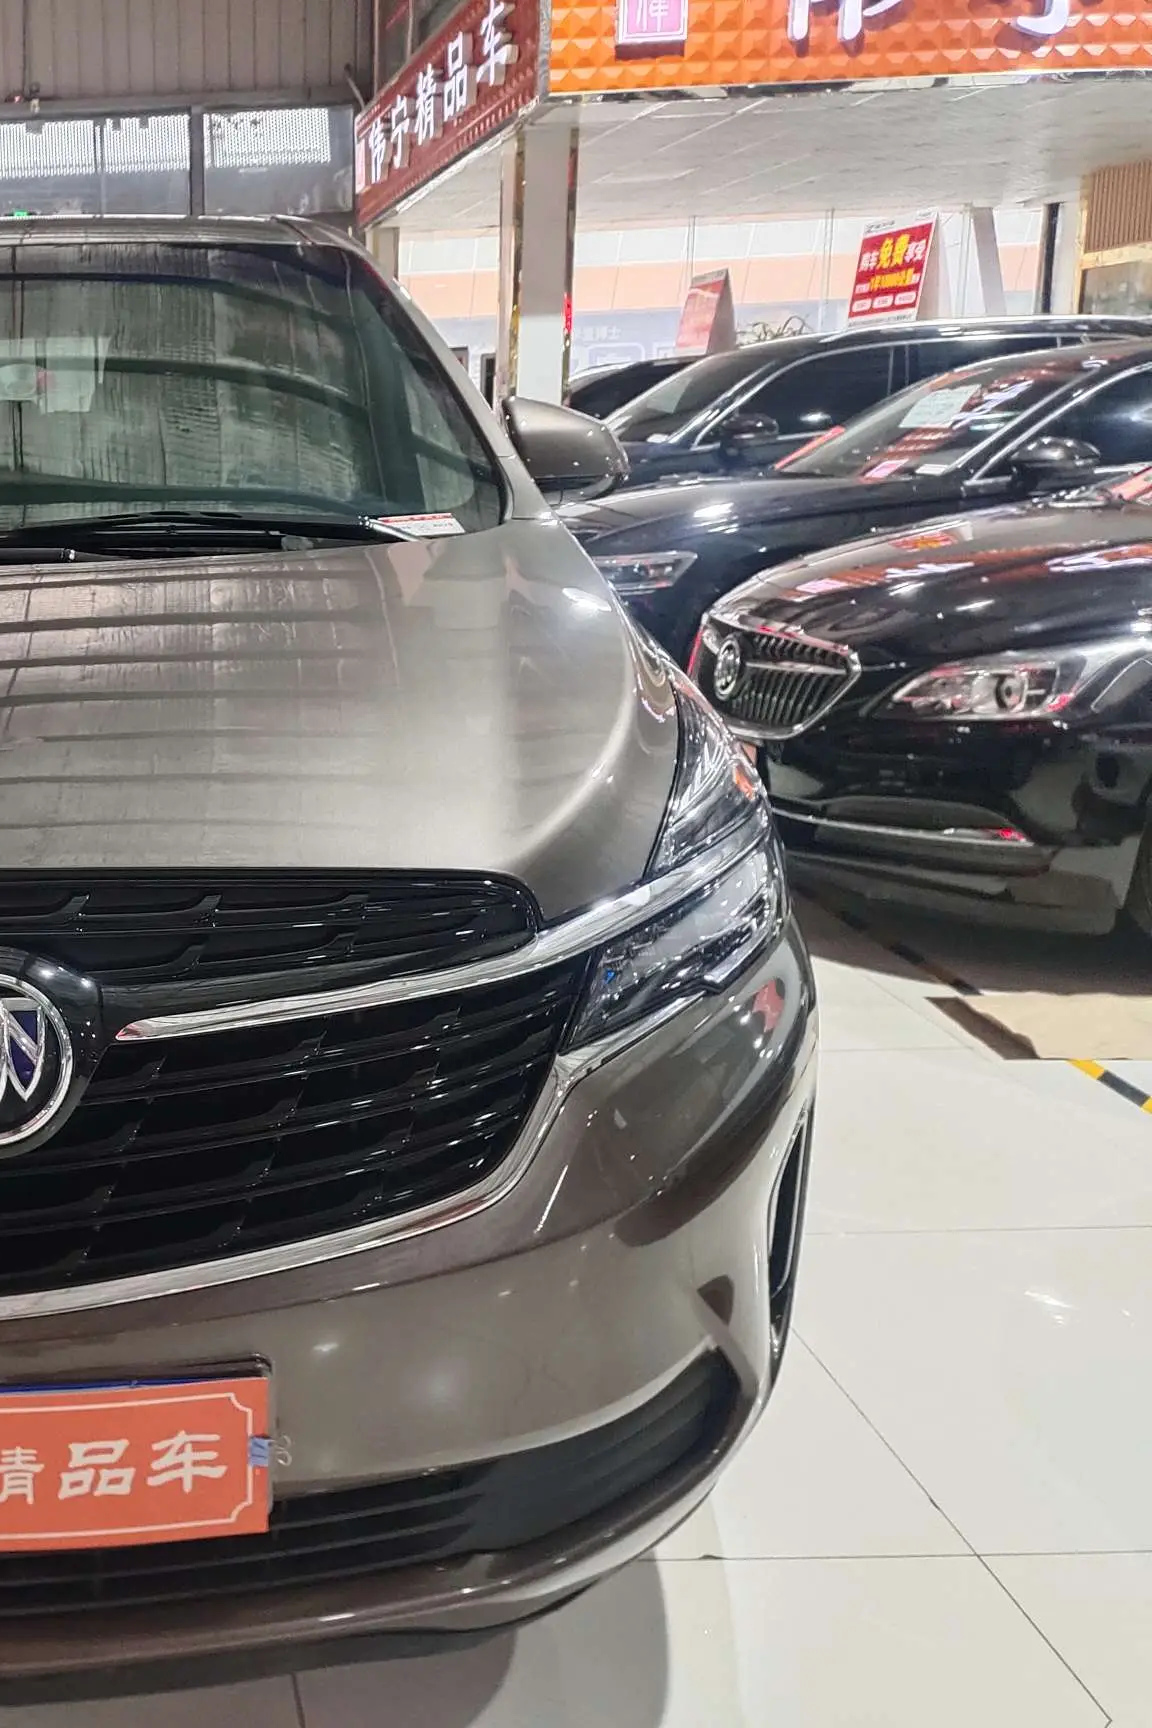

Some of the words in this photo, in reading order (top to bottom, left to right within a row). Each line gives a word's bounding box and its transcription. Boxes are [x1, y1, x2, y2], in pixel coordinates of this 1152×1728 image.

[369, 0, 508, 184] 伟宁精品车
